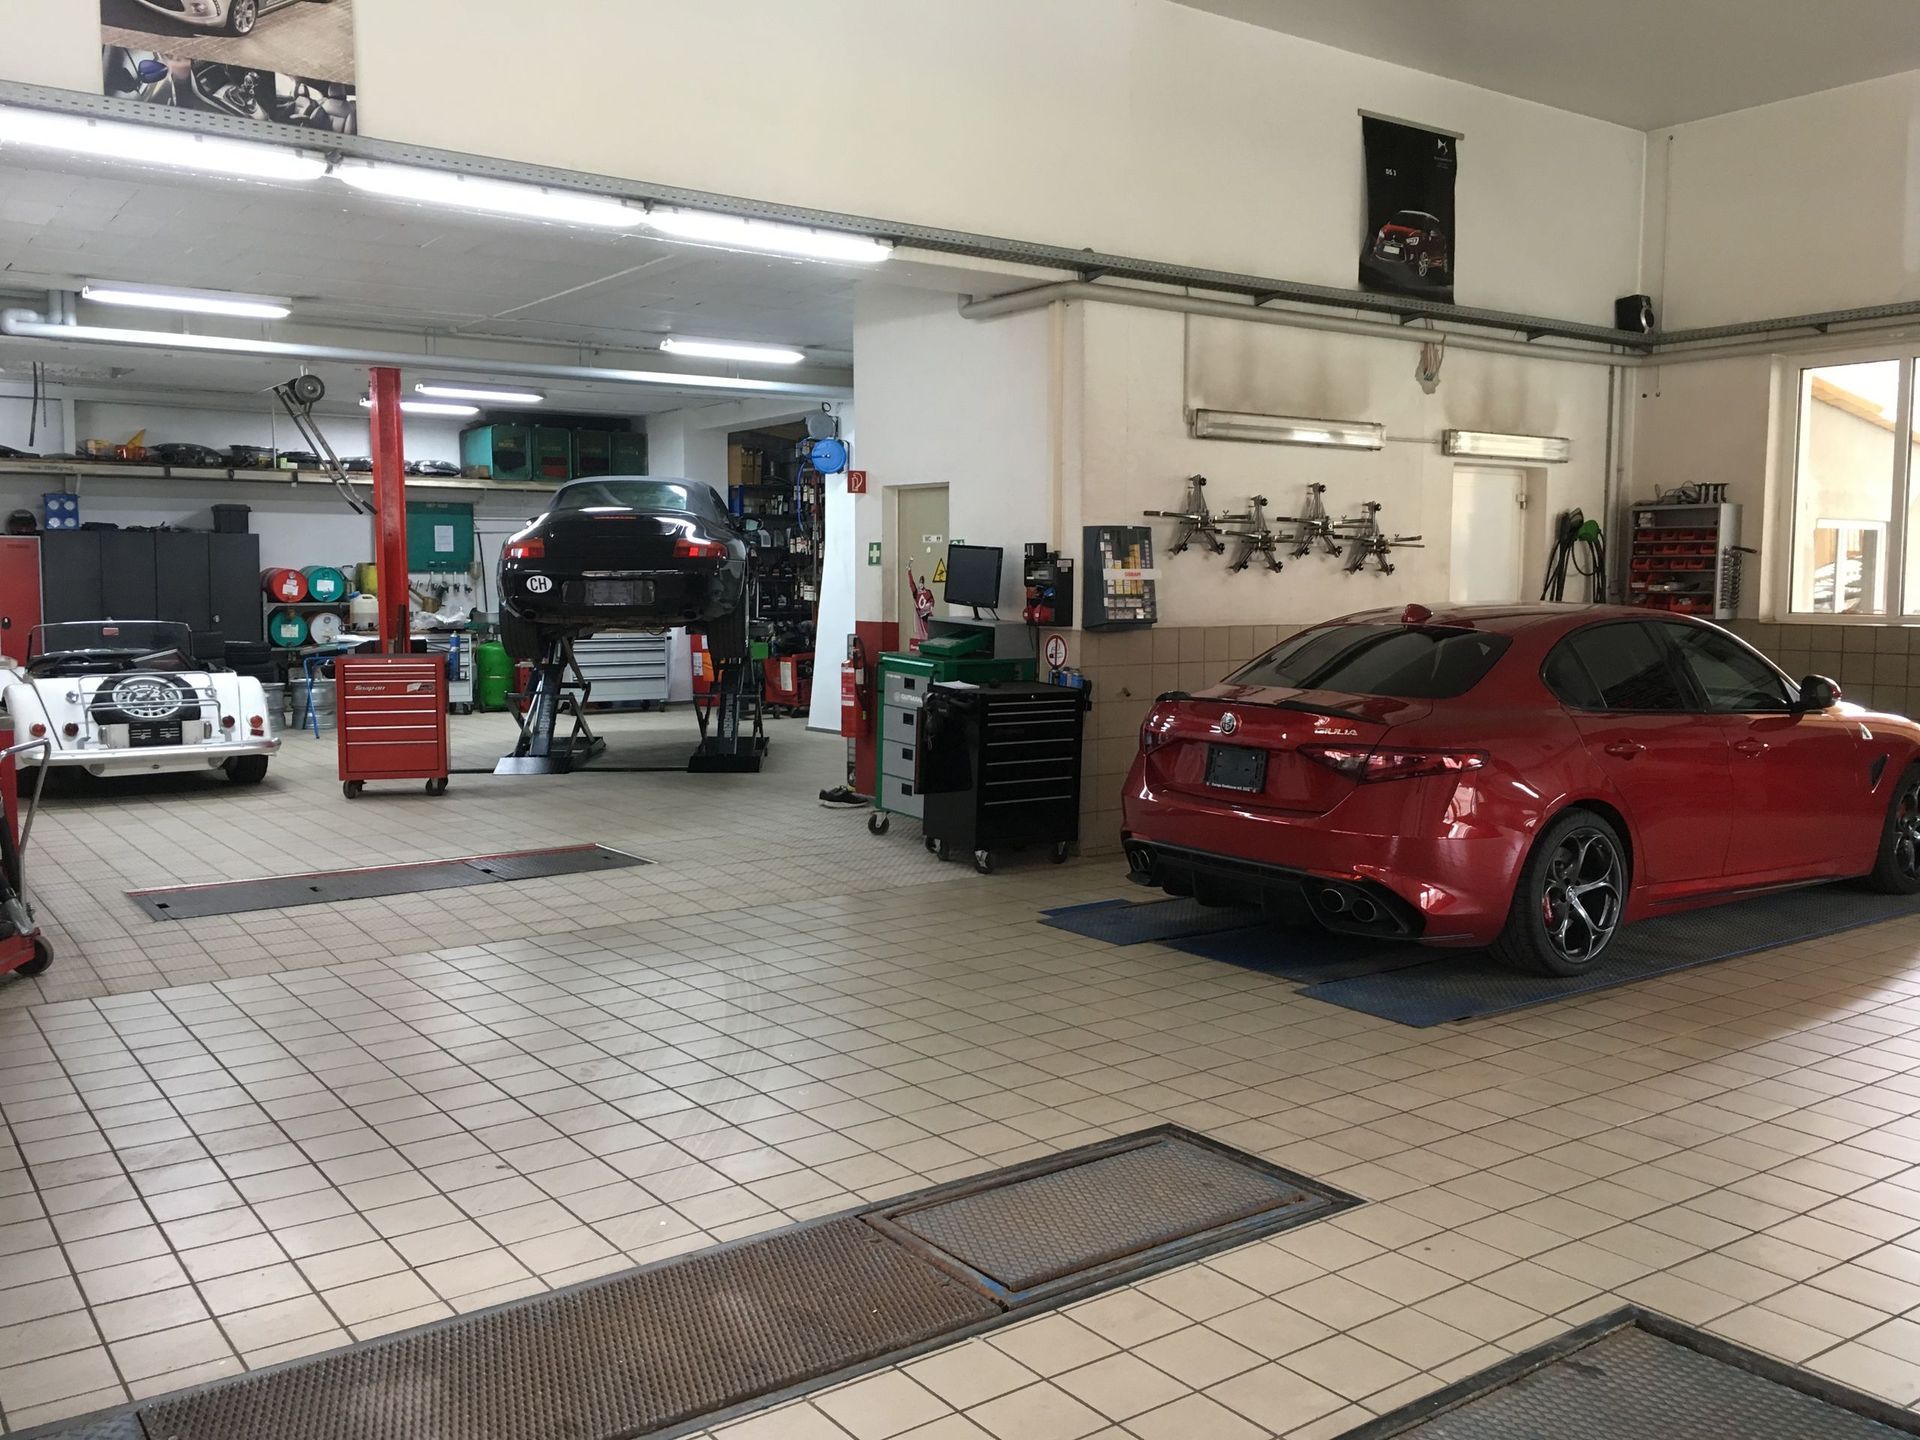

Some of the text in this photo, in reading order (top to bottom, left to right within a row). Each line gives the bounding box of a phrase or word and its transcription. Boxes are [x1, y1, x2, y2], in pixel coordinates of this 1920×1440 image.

[529, 577, 548, 591] CH
[354, 683, 386, 692] Snap-on
[1314, 727, 1358, 736] GIULIA
